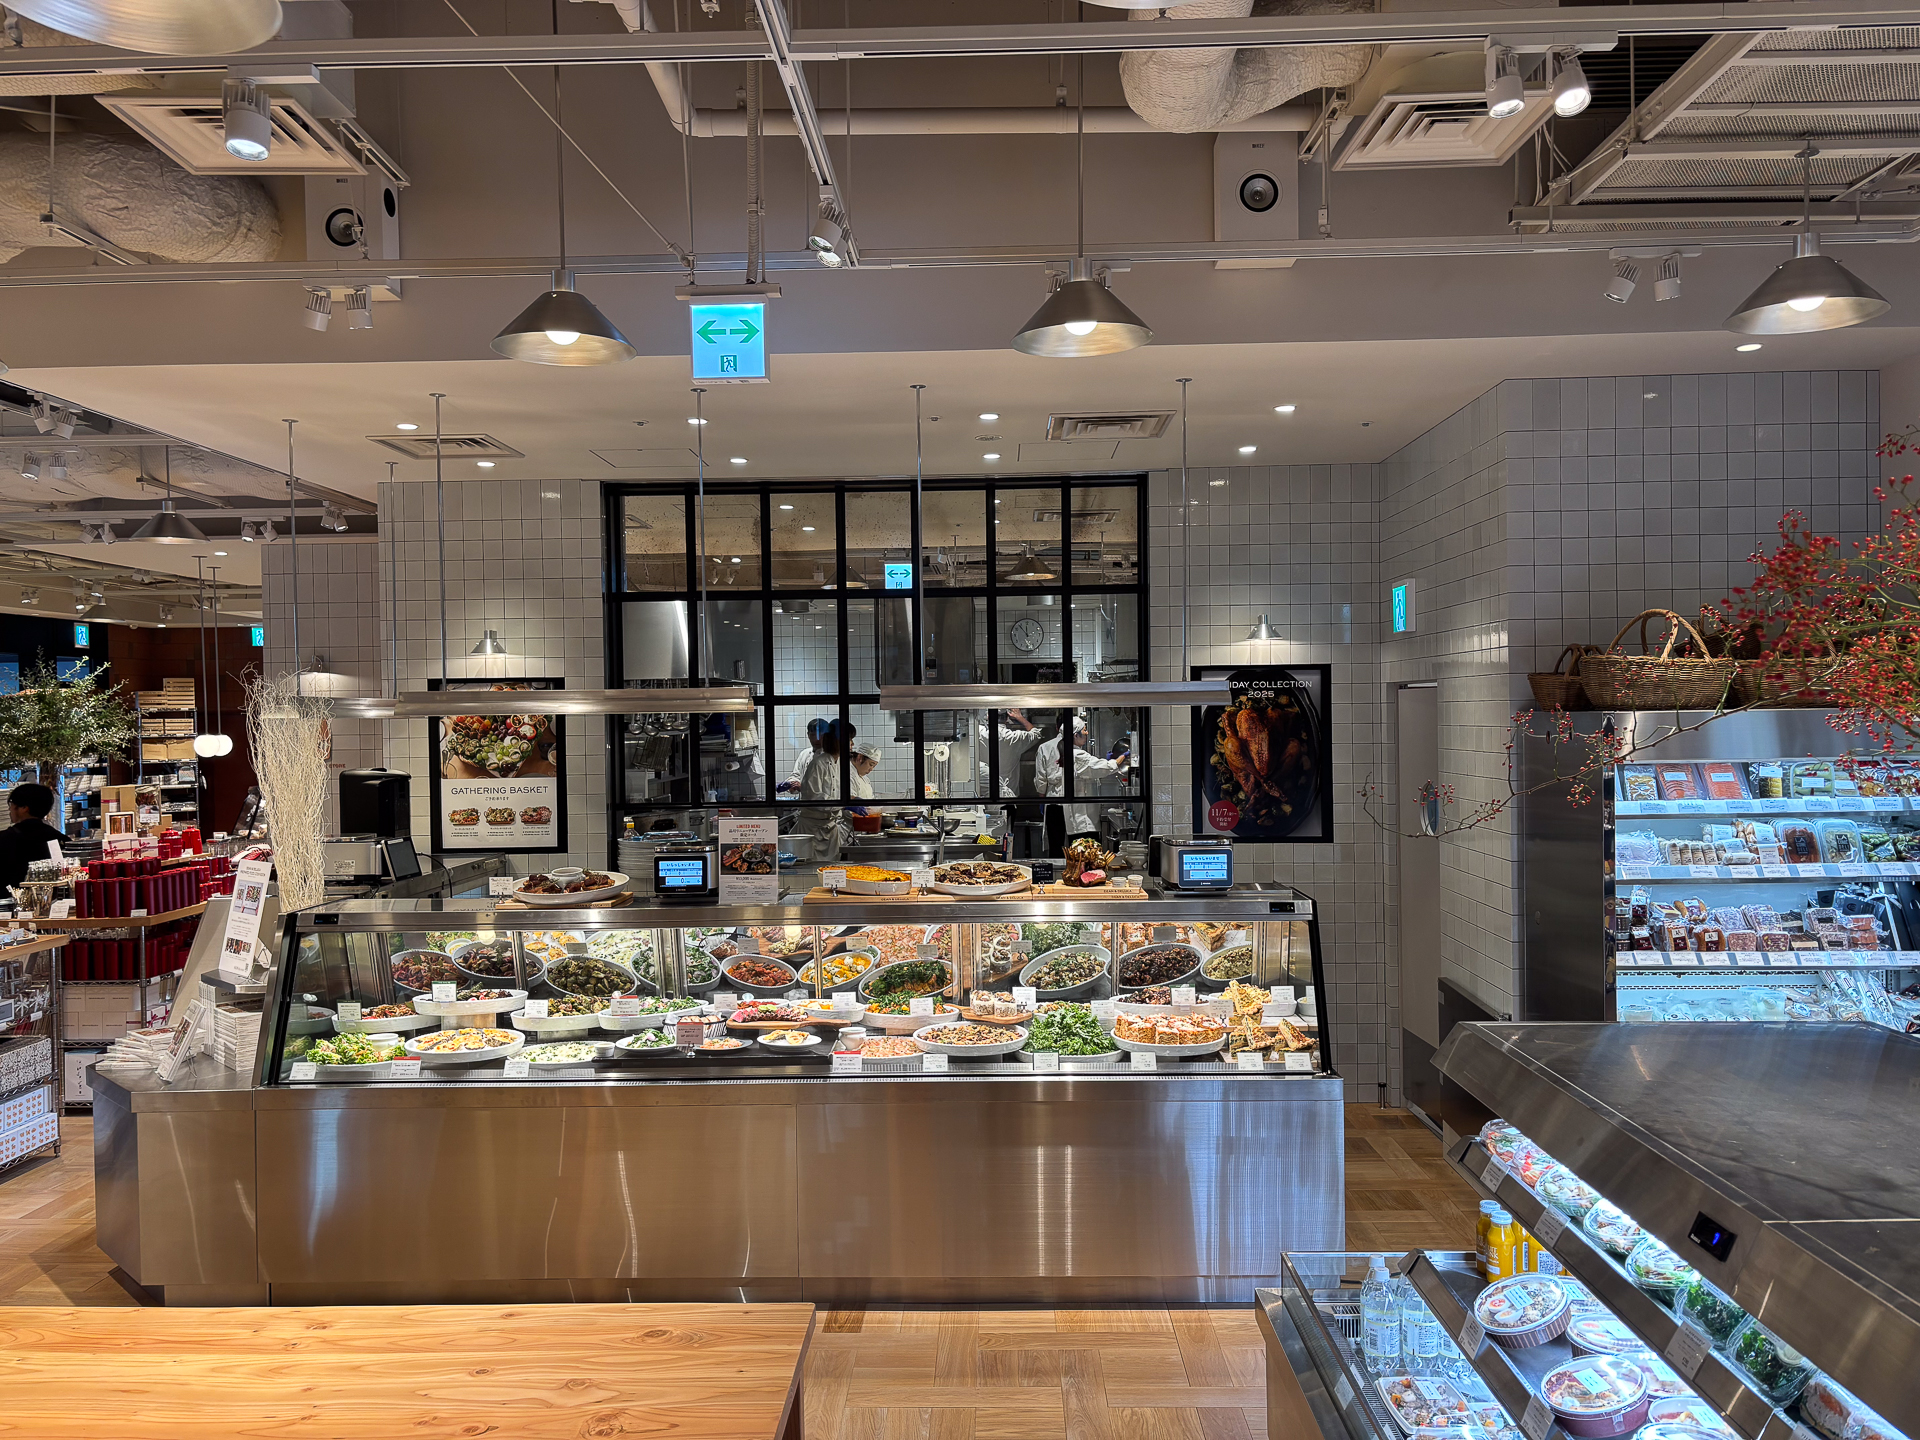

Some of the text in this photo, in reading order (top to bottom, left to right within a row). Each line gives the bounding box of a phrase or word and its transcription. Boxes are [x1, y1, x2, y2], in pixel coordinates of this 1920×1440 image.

[1229, 680, 1250, 688] IDAY
[450, 786, 549, 795] GATHERING BASKET
